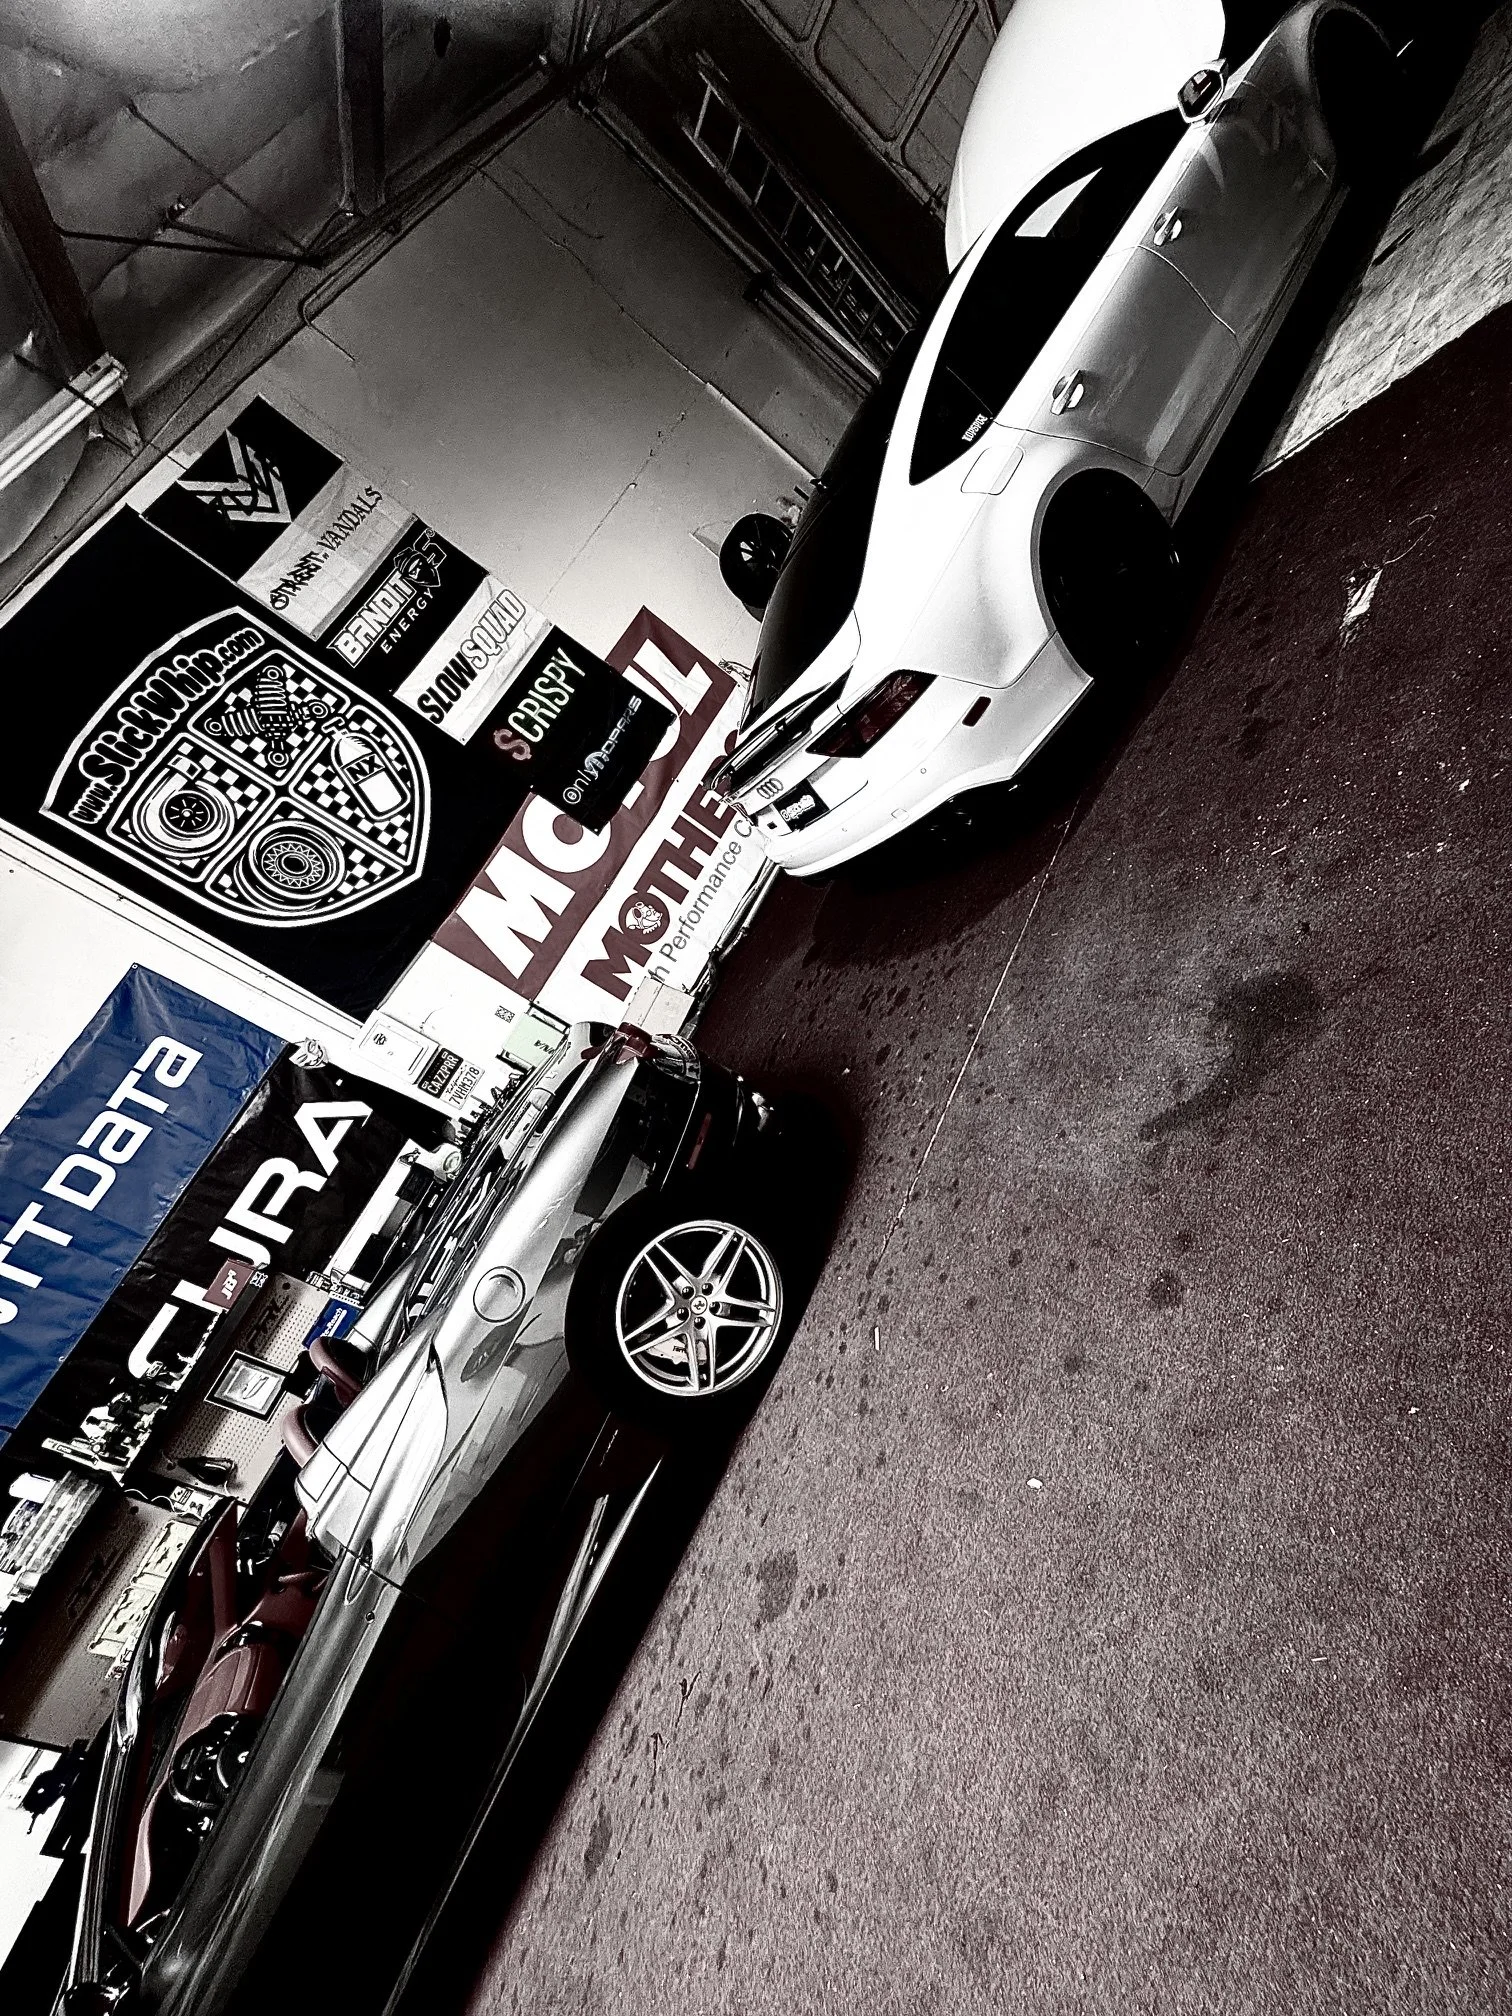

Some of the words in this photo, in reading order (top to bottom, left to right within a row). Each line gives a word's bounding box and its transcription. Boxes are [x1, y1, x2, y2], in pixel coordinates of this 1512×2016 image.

[316, 485, 383, 551] VANDALS
[331, 569, 415, 665] BANDIT
[380, 588, 434, 654] ENERGY
[345, 755, 384, 781] NX
[581, 731, 738, 1001] MOTHE
[659, 841, 742, 963] Performance
[448, 1066, 480, 1105] 7VHM378
